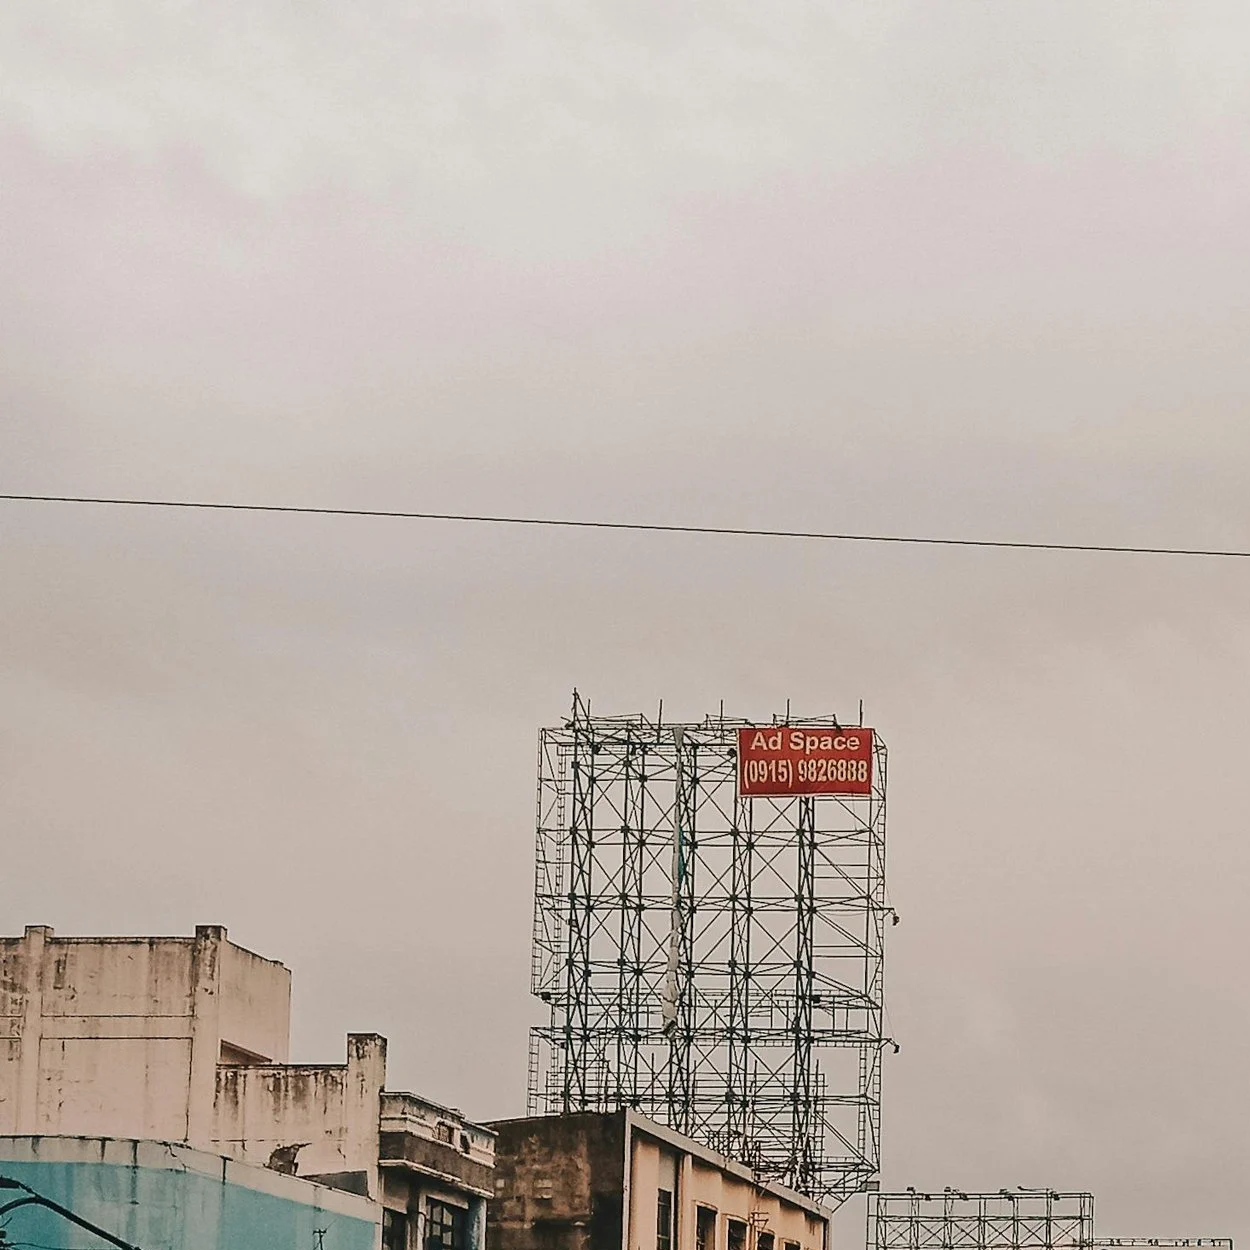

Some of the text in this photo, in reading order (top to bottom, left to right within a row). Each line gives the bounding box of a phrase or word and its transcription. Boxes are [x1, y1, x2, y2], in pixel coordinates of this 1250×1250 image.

[751, 731, 860, 755] Ad Space
[743, 759, 868, 789] (0915) 9826888
